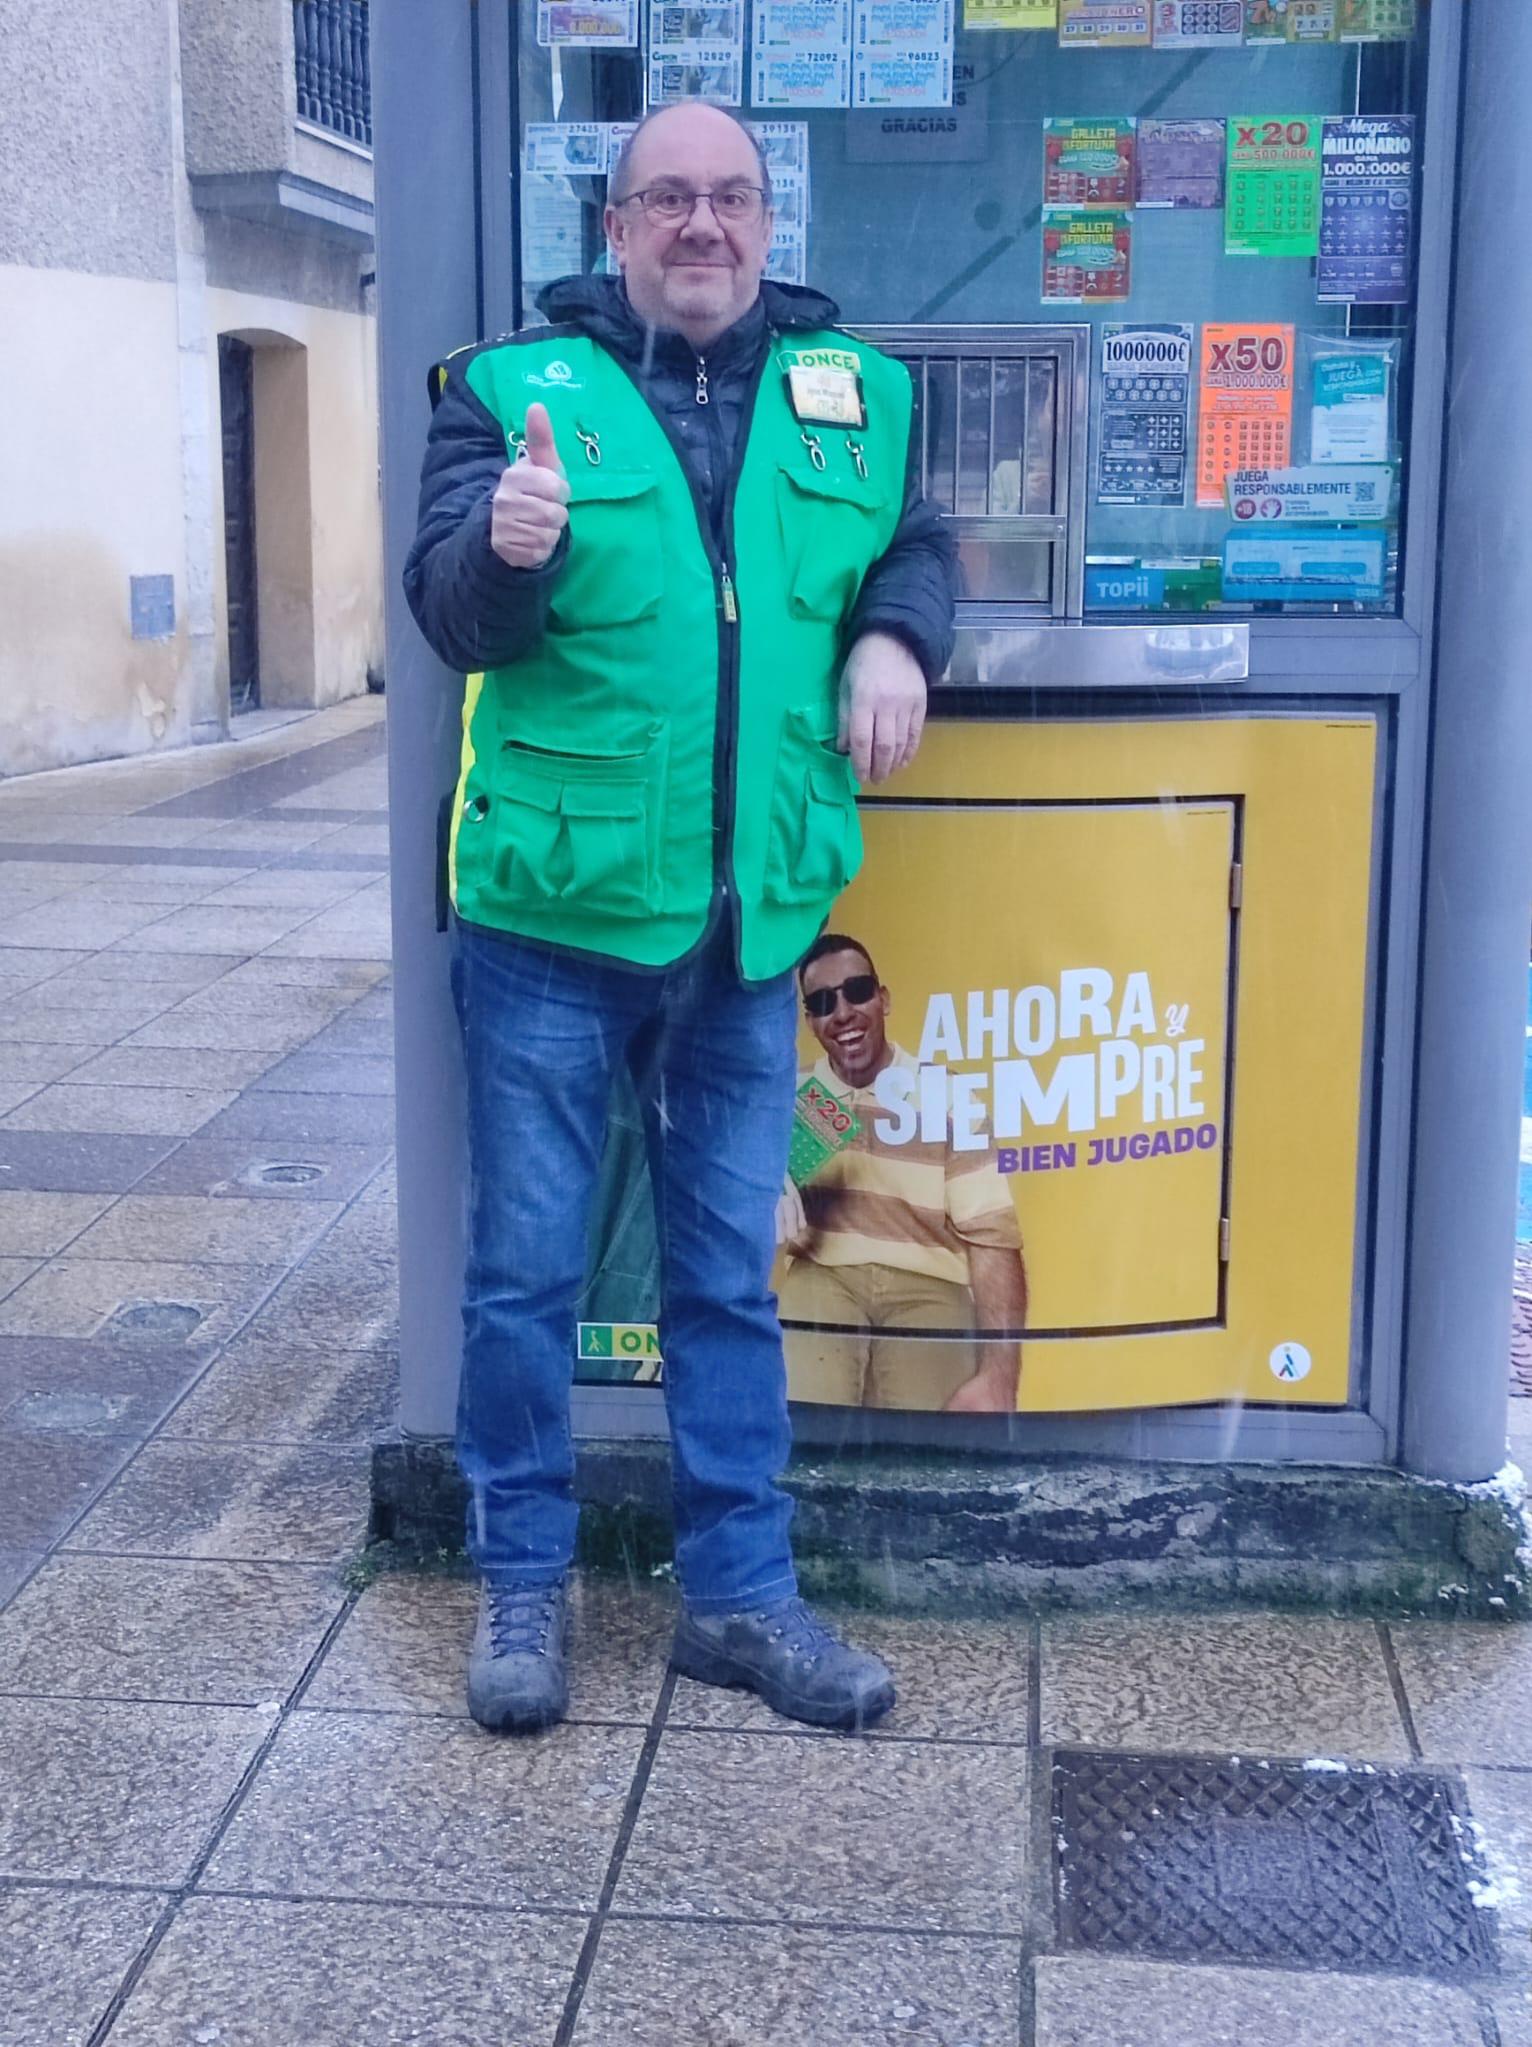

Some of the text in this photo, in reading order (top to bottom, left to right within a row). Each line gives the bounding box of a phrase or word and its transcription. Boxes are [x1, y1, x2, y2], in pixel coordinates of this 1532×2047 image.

[881, 118, 957, 133] GRACIAS
[1346, 118, 1391, 138] Mega
[1323, 136, 1412, 155] MILLONARIO
[1323, 162, 1412, 175] 1.000.000€
[1106, 341, 1187, 362] 1000000€
[802, 353, 855, 370] ONCE
[1225, 374, 1287, 389] 1.000.000€
[1234, 470, 1269, 482] JUEGA
[1234, 483, 1352, 496] RESPONSABLEMENTE
[918, 967, 1157, 1063] AHORA
[873, 1038, 1206, 1153] SIEMPRE
[997, 1123, 1217, 1174] BIEN JUGADO
